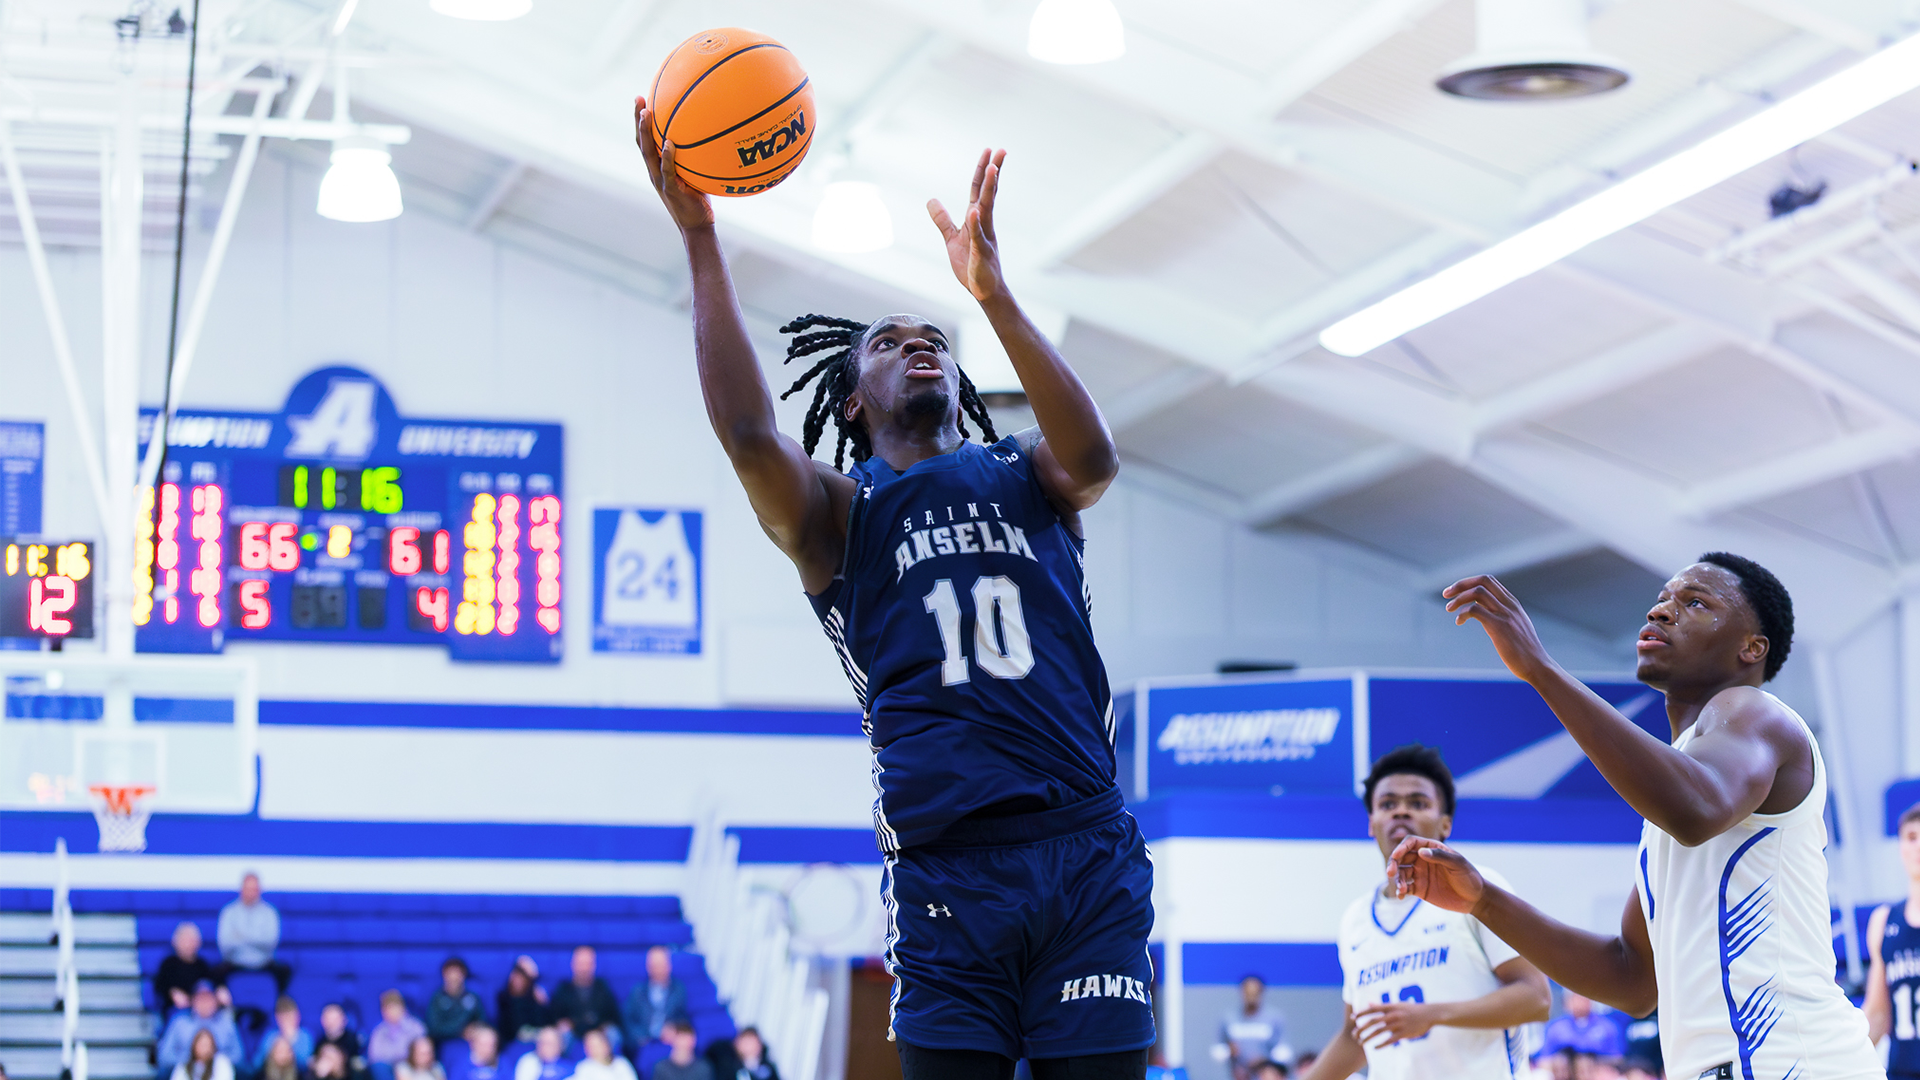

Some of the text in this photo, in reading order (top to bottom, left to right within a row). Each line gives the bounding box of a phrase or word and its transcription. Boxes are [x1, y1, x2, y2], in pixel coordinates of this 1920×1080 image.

[735, 136, 757, 145] BALL
[737, 110, 806, 168] NCAA
[757, 124, 779, 138] GAME
[904, 503, 1003, 533] SAINT
[240, 522, 300, 571] 66
[390, 526, 449, 575] 61
[895, 521, 1038, 585] ANSELM
[616, 551, 679, 602] 24
[29, 575, 77, 634] 12
[239, 579, 449, 632] 5 4
[922, 575, 1035, 687] 10
[1060, 974, 1147, 1004] HAWKS
[1358, 945, 1450, 987] ASSUMPTION
